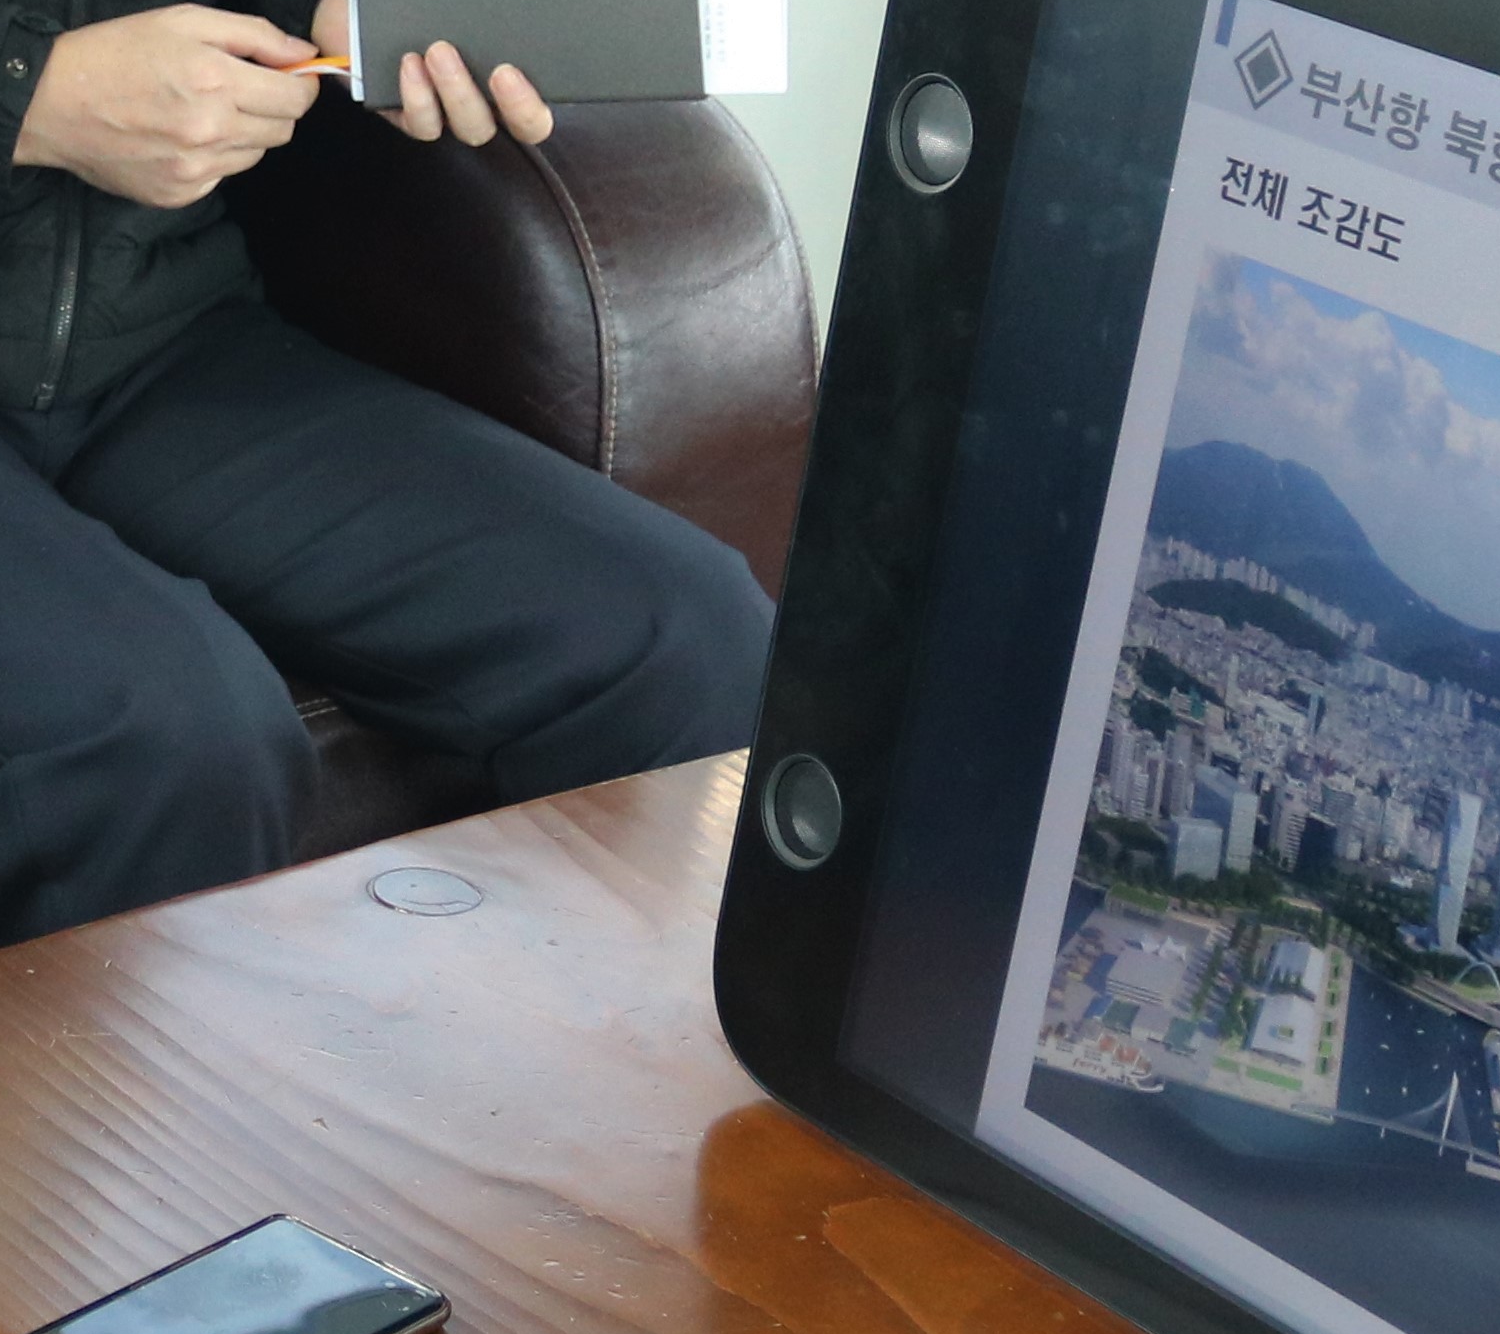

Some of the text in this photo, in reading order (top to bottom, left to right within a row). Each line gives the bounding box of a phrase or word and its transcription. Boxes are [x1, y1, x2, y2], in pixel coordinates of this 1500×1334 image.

[1300, 62, 1431, 152] 부산항
[1220, 156, 1406, 262] 전체 조감도
